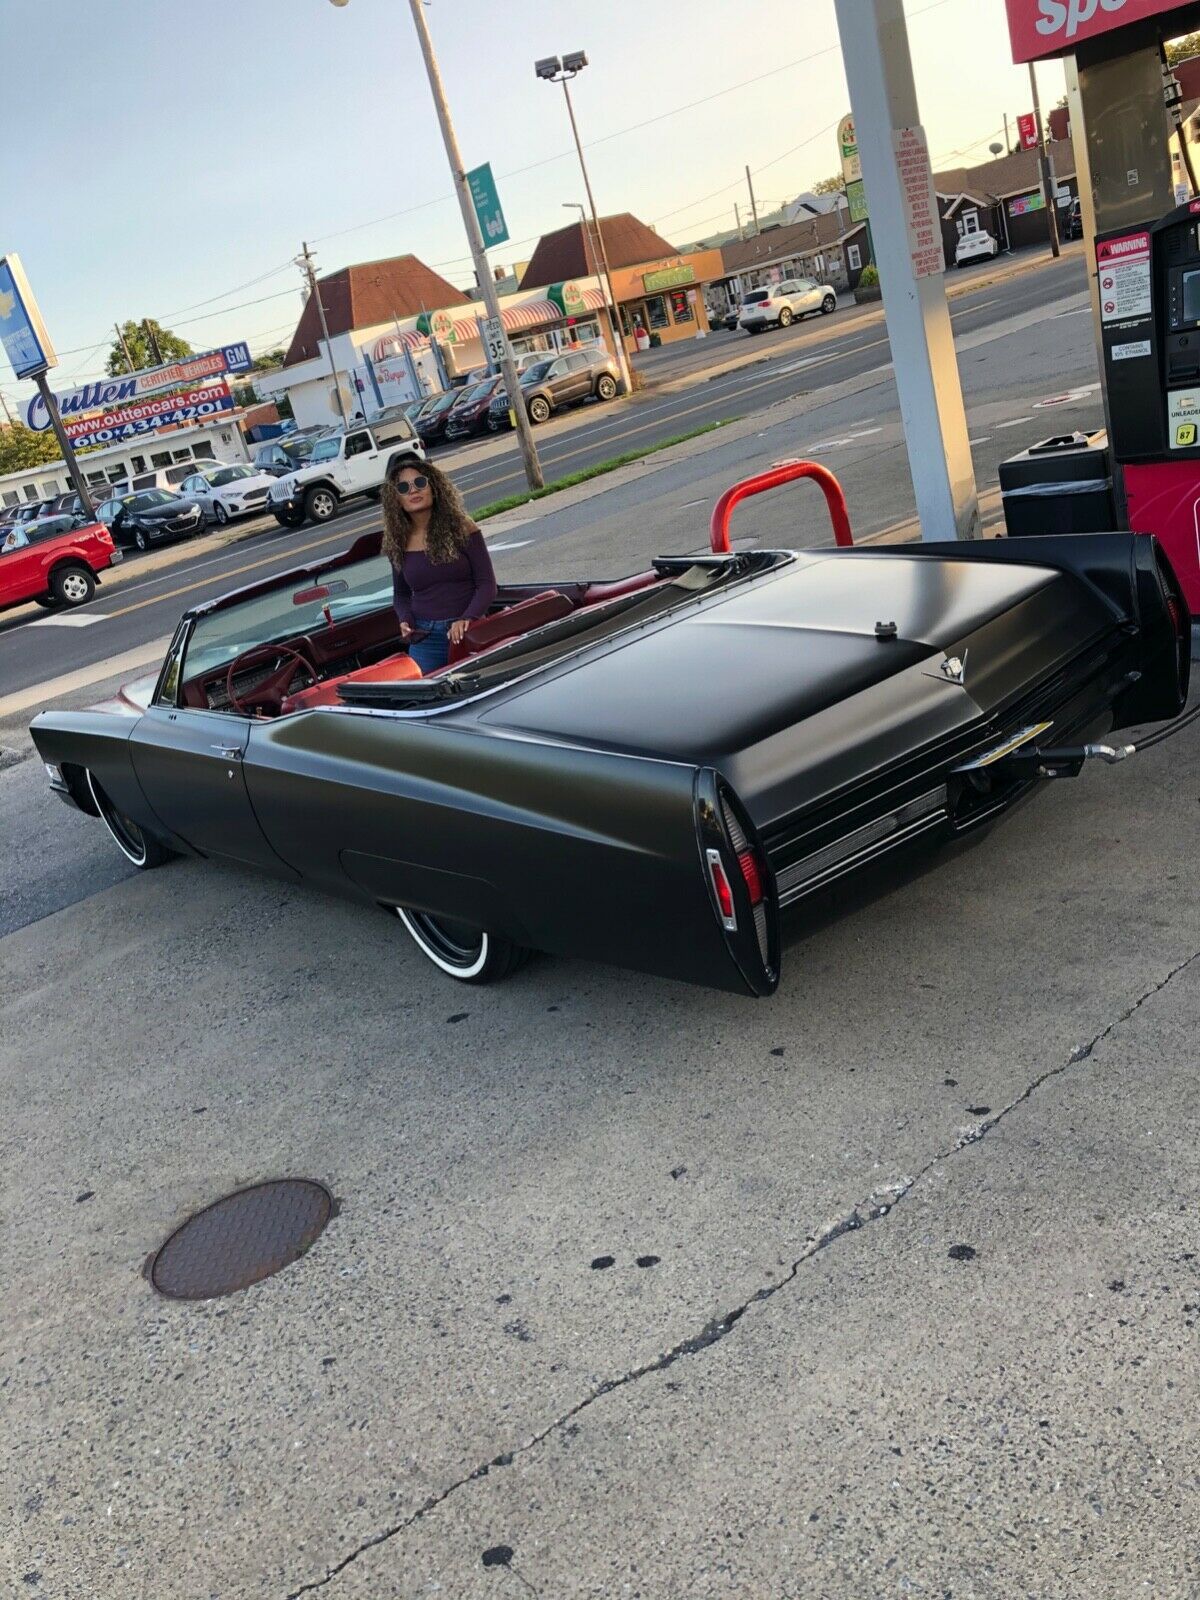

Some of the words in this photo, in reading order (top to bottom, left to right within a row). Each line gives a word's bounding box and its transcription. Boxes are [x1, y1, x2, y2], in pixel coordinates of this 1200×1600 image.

[1109, 237, 1148, 255] WARNING
[225, 347, 248, 364] GM
[489, 340, 506, 359] 35
[27, 379, 138, 432] Outten
[140, 367, 182, 389] CERTIFIED
[183, 355, 223, 377] VEHICLES
[65, 385, 225, 437] www.outtencars.com
[1179, 430, 1191, 441] 87
